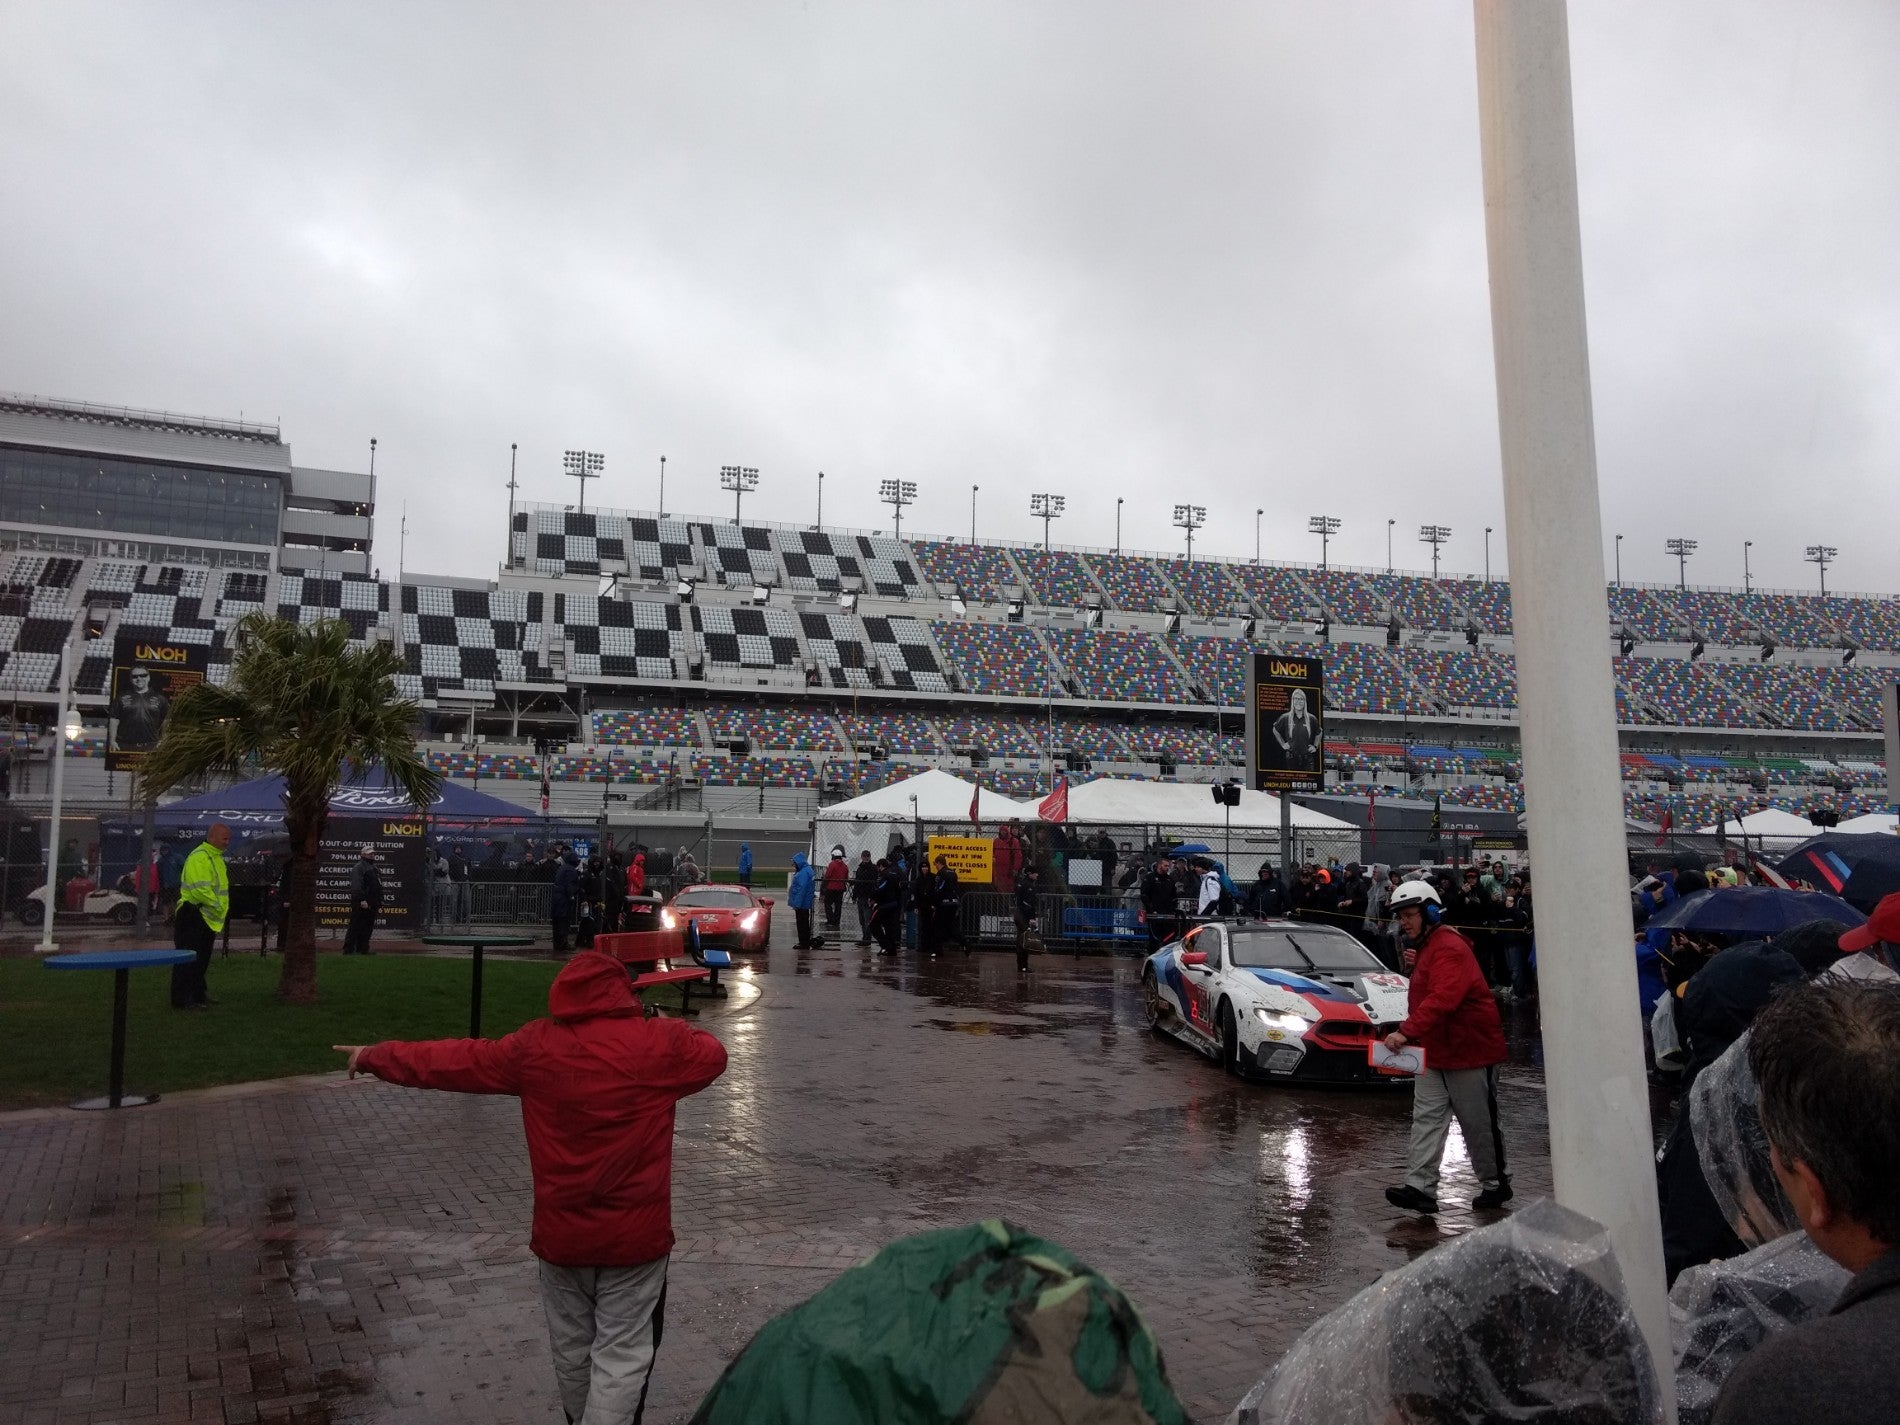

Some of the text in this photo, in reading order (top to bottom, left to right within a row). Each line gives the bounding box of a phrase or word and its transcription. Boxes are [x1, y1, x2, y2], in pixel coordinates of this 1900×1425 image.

[135, 643, 187, 661] UNOH
[1270, 660, 1308, 676] UNOH
[330, 790, 411, 806] Ford
[383, 822, 423, 835] UNOH
